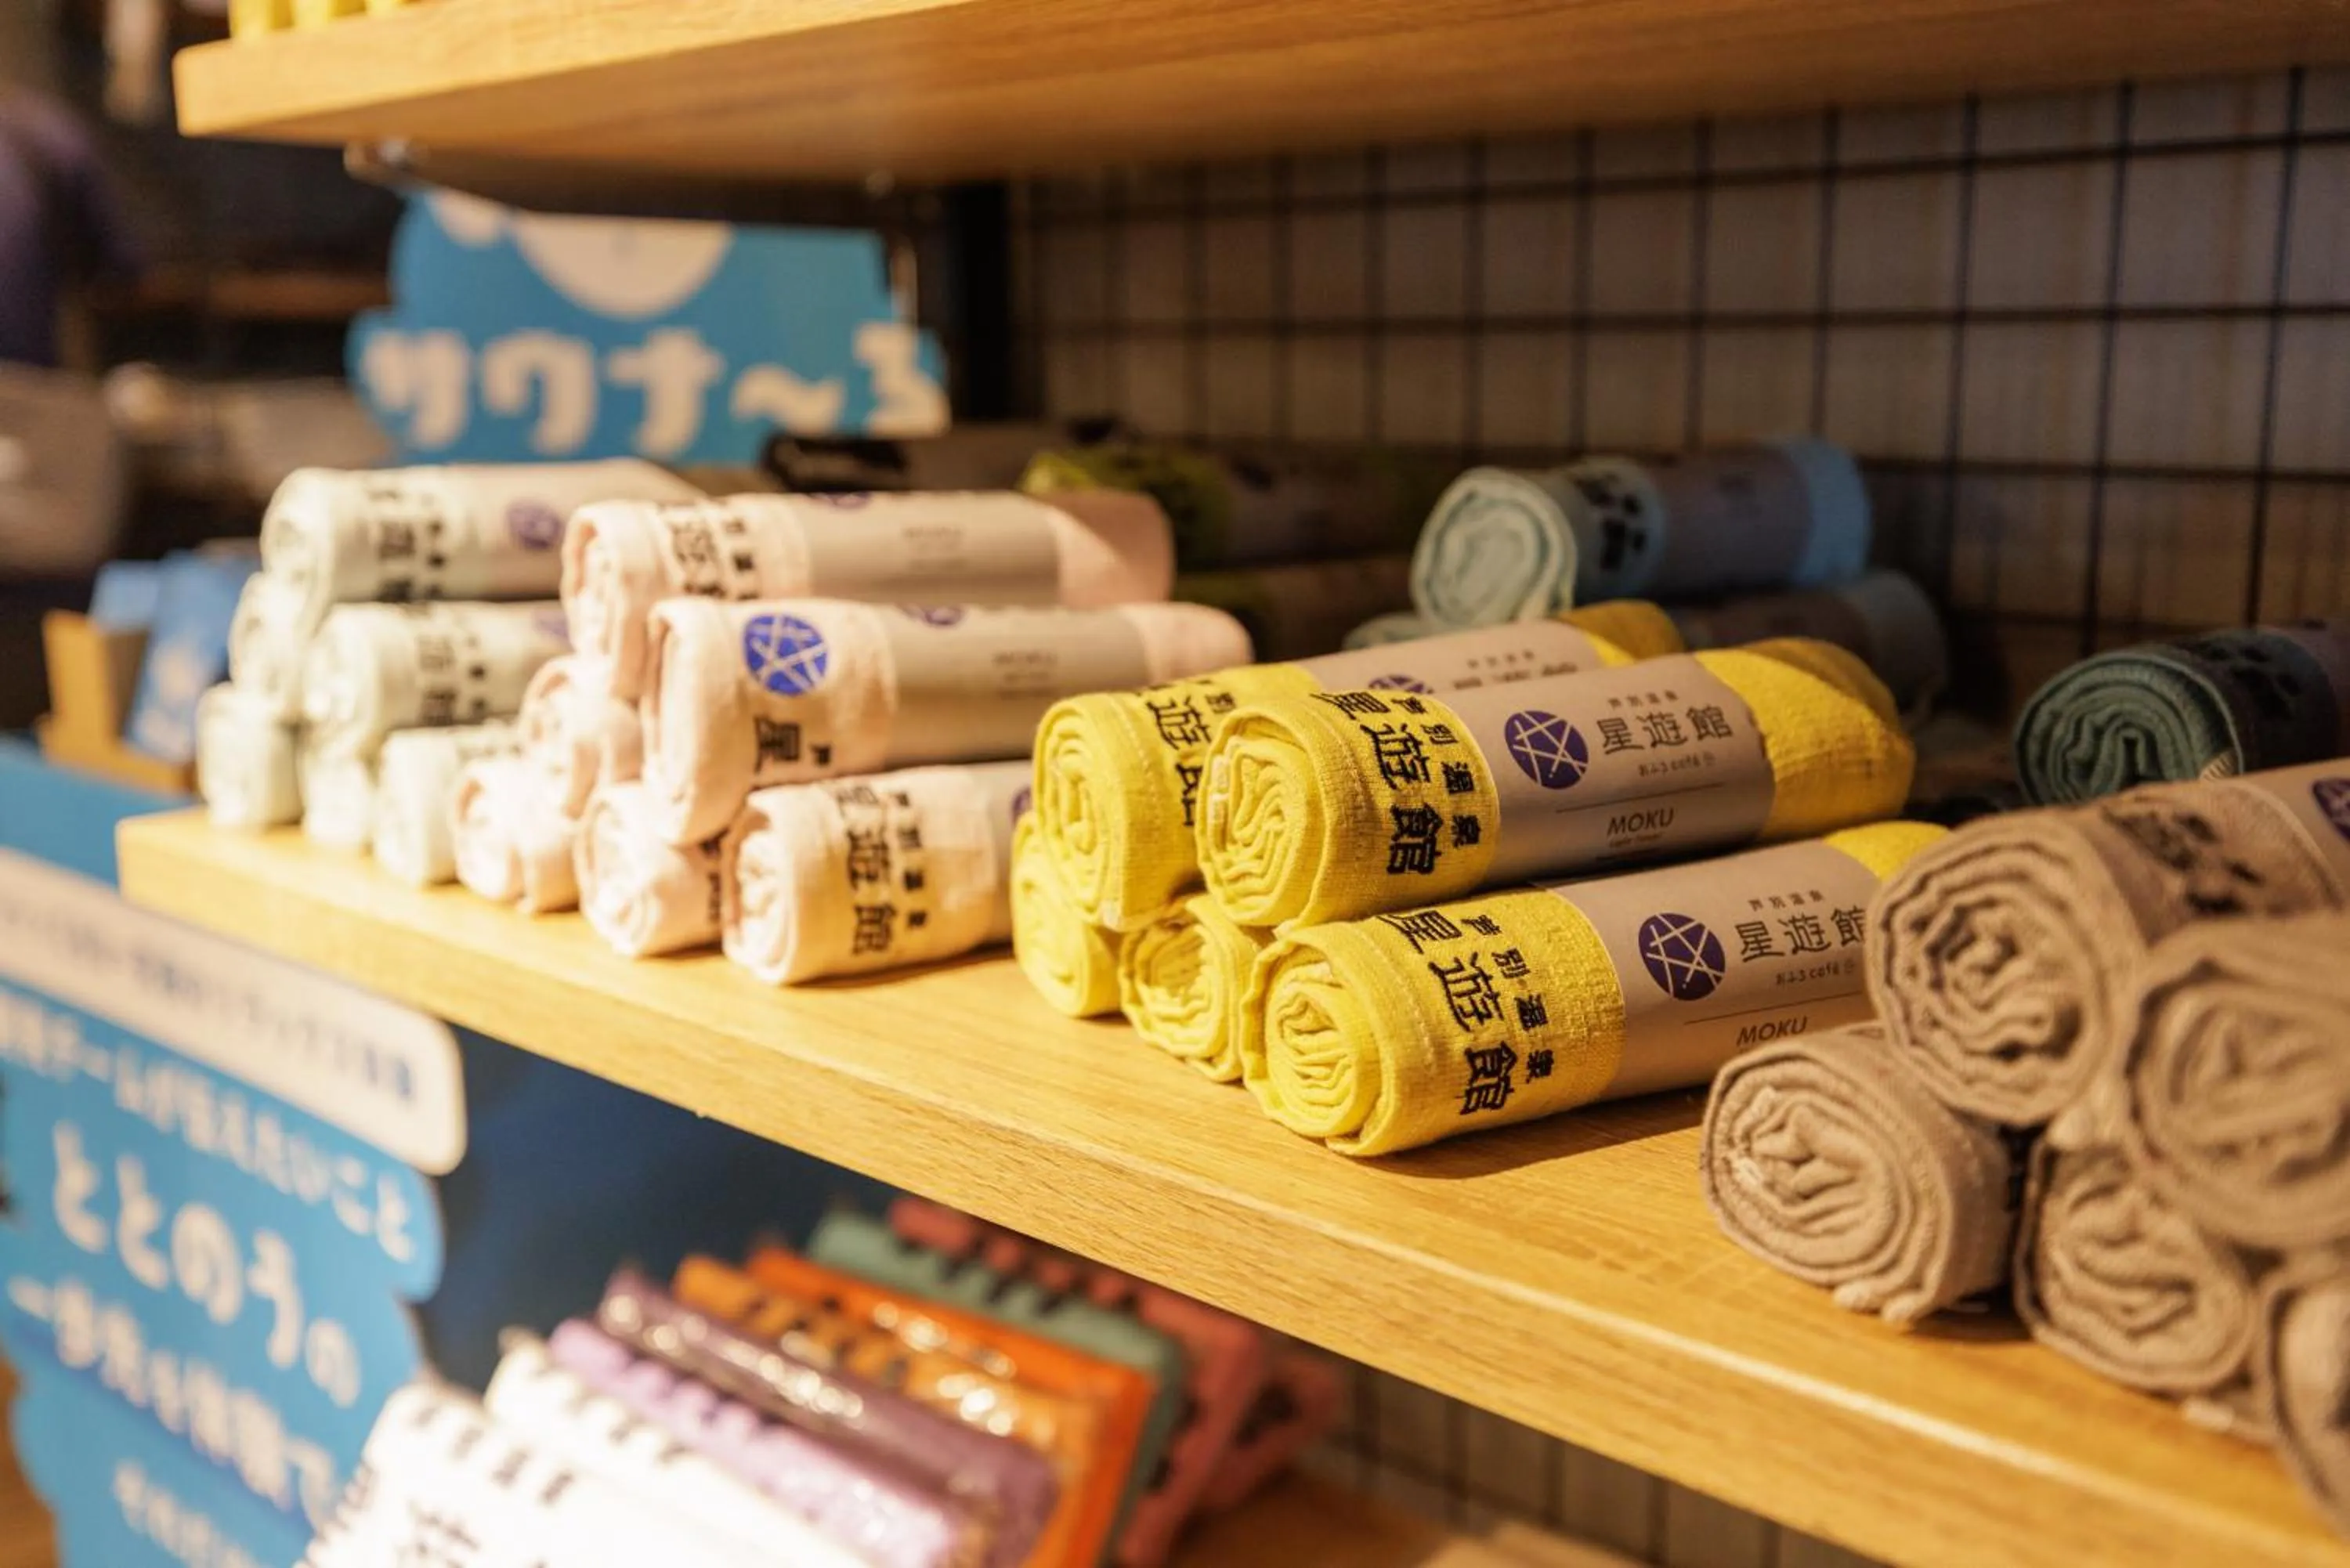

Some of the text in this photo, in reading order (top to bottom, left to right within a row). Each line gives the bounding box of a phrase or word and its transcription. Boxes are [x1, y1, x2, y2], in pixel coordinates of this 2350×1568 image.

[1311, 689, 1448, 876] 星遊館
[1596, 703, 1735, 756] 星遊館
[1606, 807, 1676, 837] MOKU
[1376, 909, 1520, 1117] 星遊館
[1462, 914, 1555, 1084] 芦別温泉
[1735, 1015, 1809, 1048] MOKU
